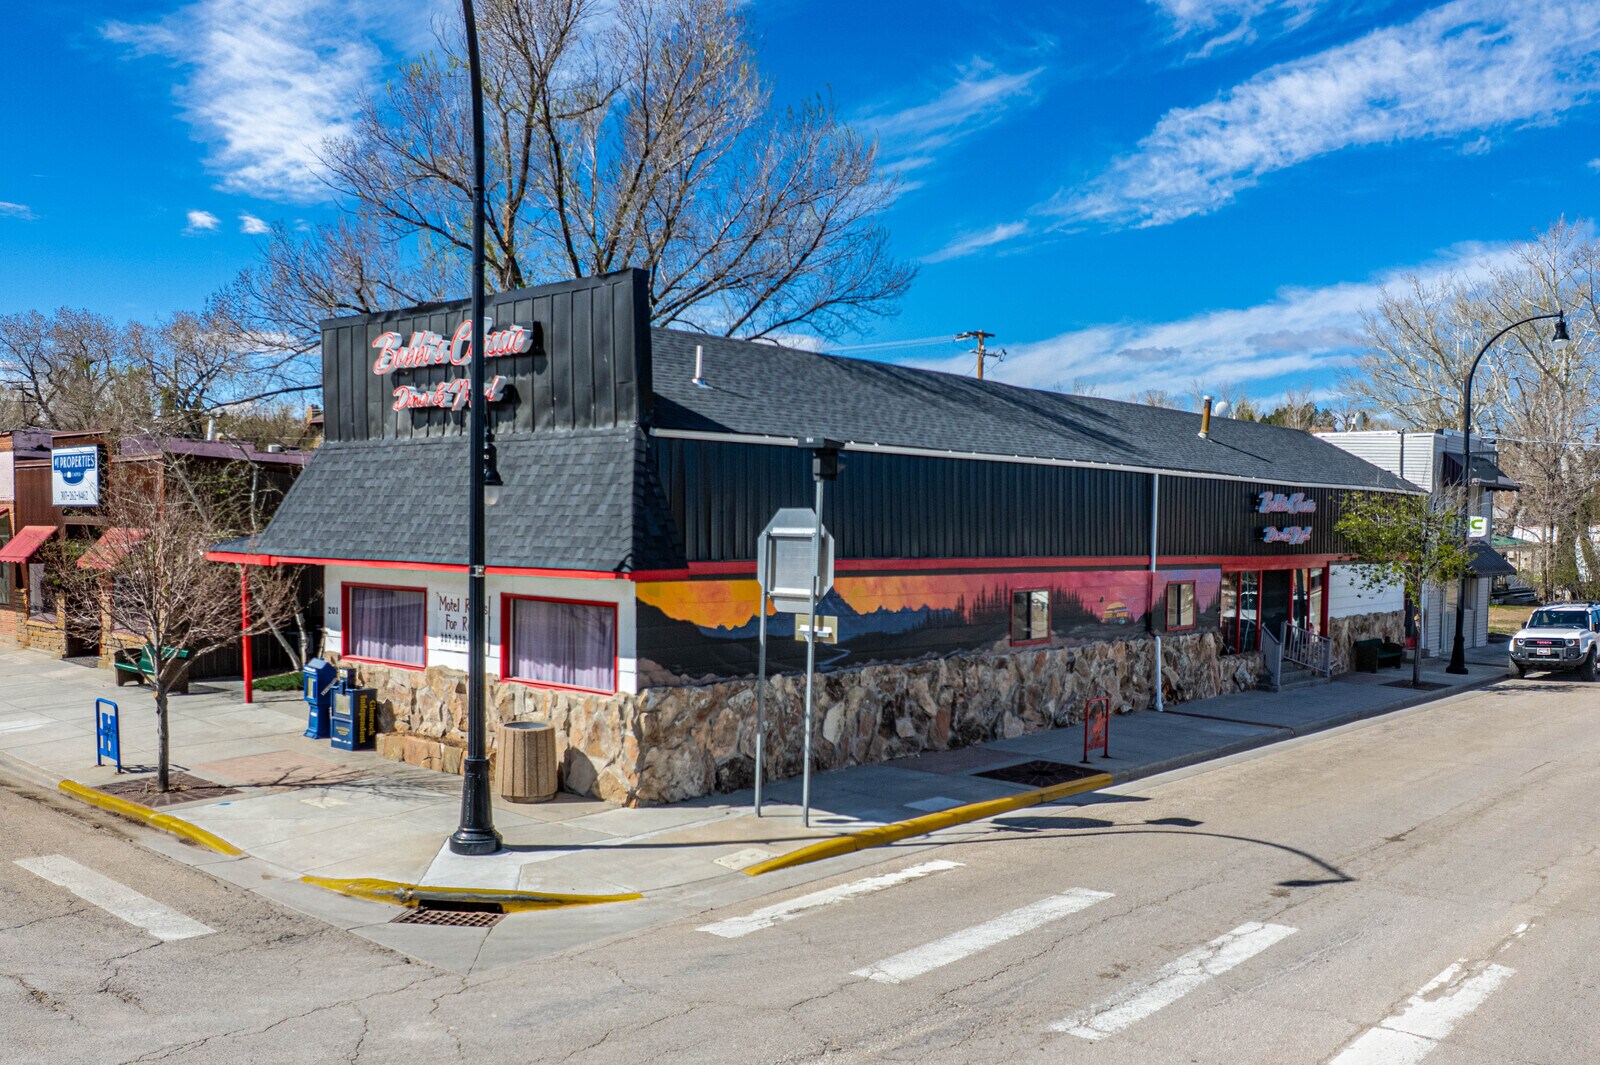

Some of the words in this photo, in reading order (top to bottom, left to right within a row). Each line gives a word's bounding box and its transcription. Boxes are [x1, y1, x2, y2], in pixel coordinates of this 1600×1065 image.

[372, 331, 449, 375] Bobbi's
[450, 317, 532, 365] Cssic
[392, 385, 430, 411] Diner
[60, 454, 95, 468] PROPERTIES
[327, 606, 339, 615] 201
[439, 595, 460, 613] Motel
[445, 613, 457, 630] For
[359, 695, 368, 743] Independent
[368, 700, 376, 736] Glenrock
